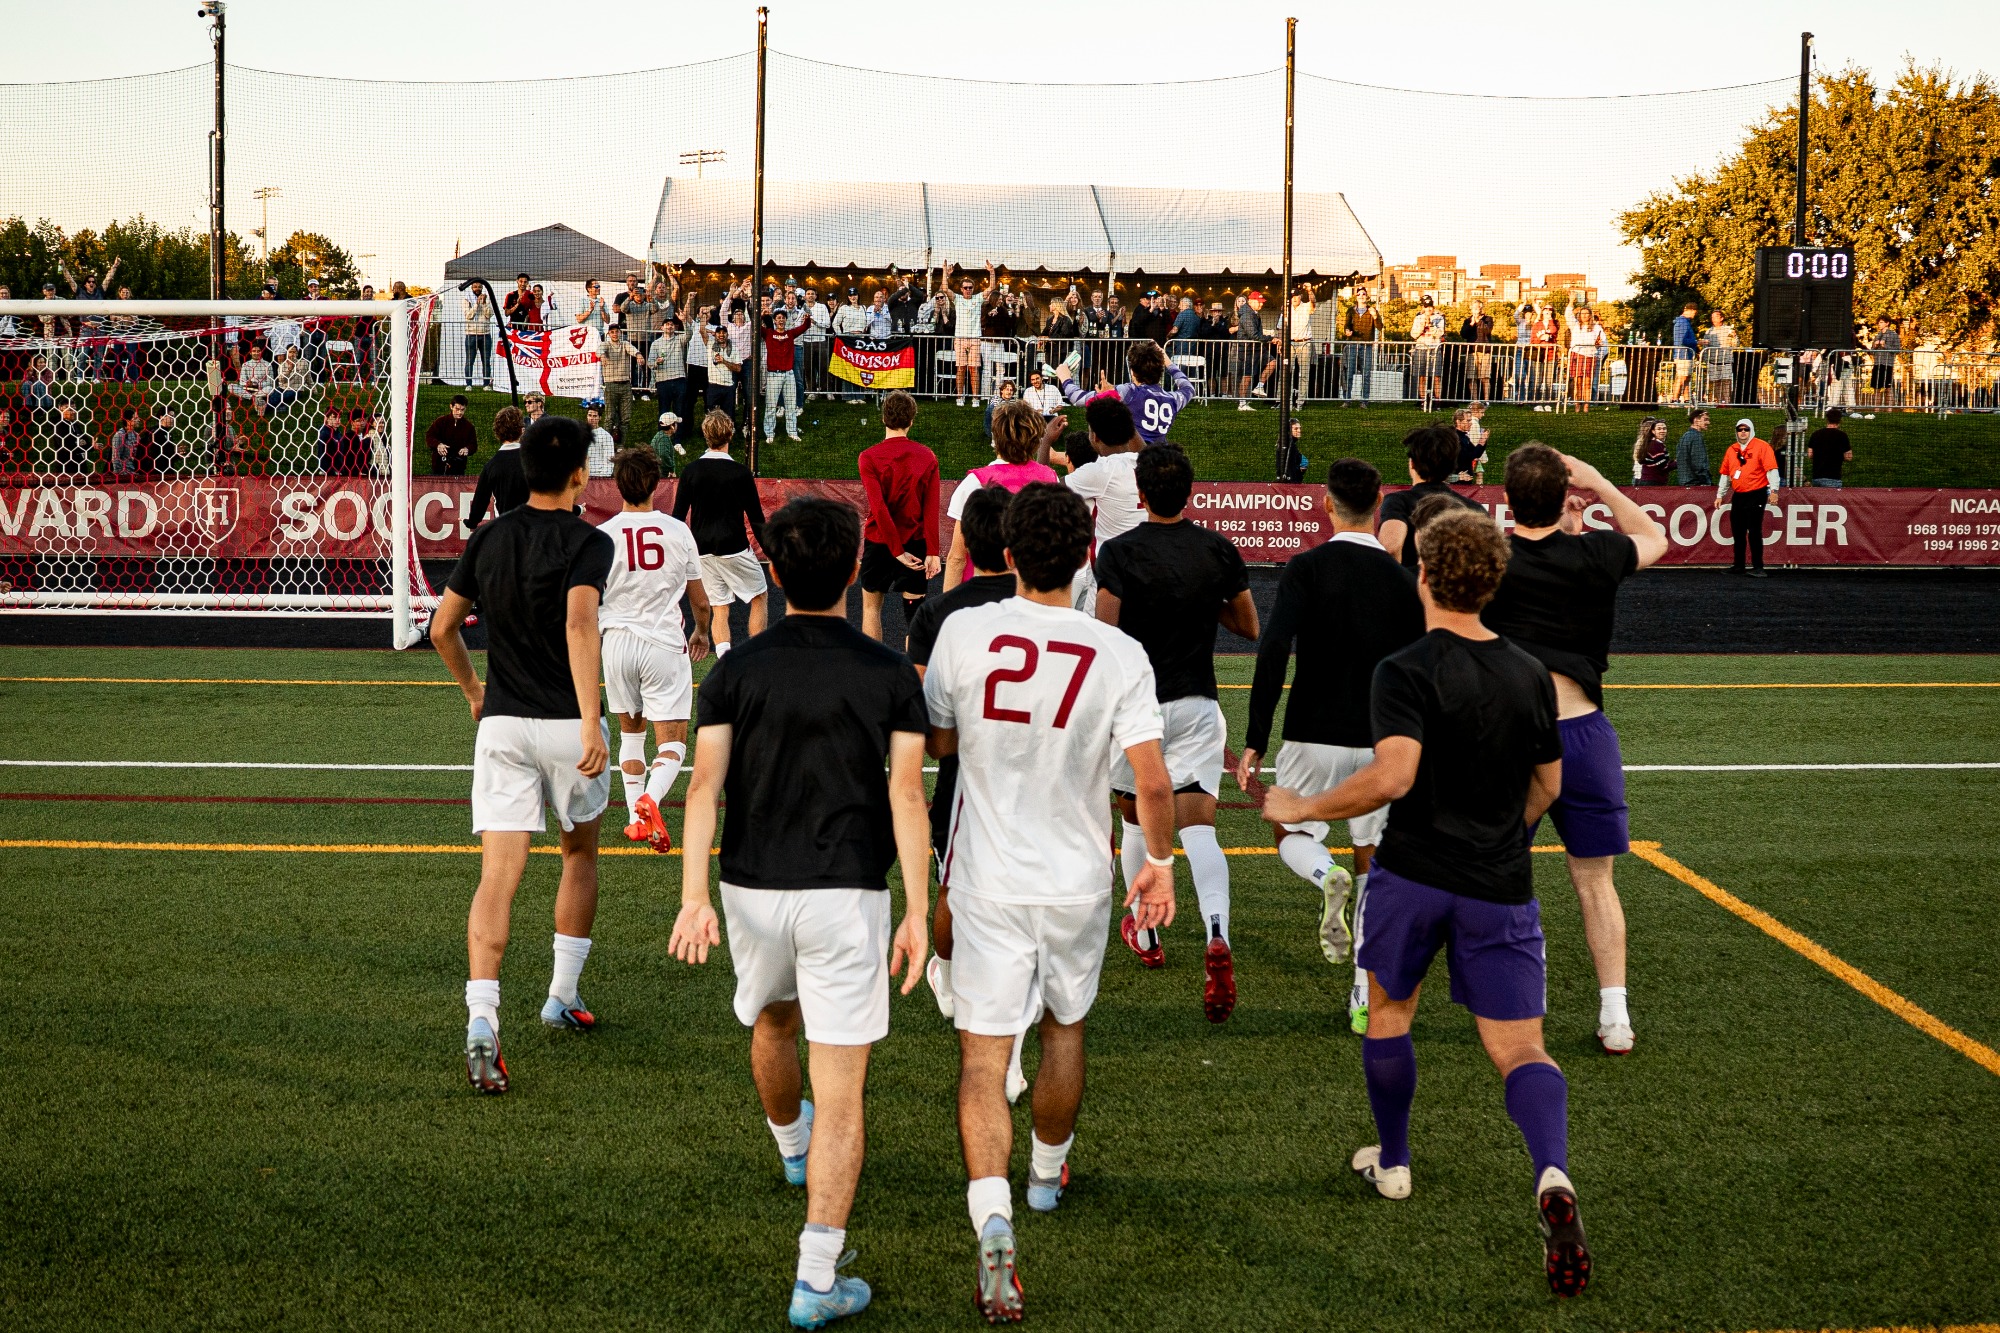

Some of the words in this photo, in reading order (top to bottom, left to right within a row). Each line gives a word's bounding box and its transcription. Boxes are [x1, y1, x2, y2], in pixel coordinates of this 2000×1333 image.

[1788, 252, 1848, 279] 0:00
[855, 339, 887, 351] DAS
[546, 357, 563, 368] ON
[565, 352, 593, 366] TOUR
[841, 345, 902, 369] CRIMSON
[1141, 398, 1174, 434] 99
[1192, 493, 1313, 511] CHAMPIONS
[1950, 498, 2000, 514] NCAA
[1214, 520, 1246, 532] 1962
[1251, 520, 1283, 532] 1963
[1288, 521, 1320, 533] 1969
[1906, 524, 1938, 535] 1968
[1941, 524, 1972, 535] 1969
[1975, 524, 2000, 535] 197
[621, 526, 665, 572] 16
[1231, 536, 1264, 548] 2006
[1267, 536, 1301, 548] 2009
[1923, 540, 1954, 551] 1994
[1958, 540, 1988, 551] 1996
[983, 633, 1097, 729] 27
